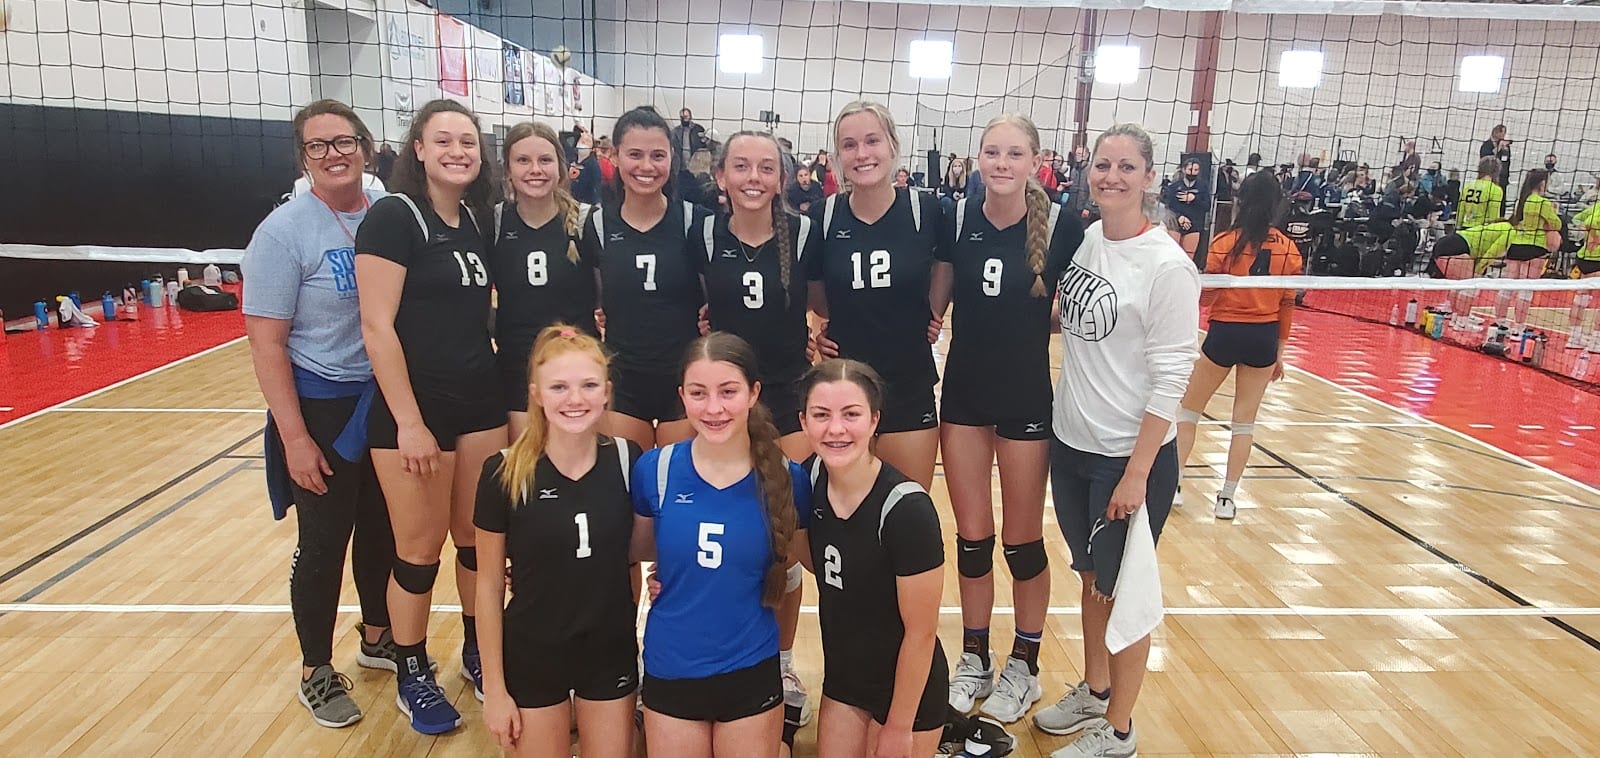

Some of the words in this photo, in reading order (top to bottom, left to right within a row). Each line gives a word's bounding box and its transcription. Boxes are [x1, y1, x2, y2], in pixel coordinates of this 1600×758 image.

[1465, 189, 1482, 204] 23
[453, 251, 488, 286] 13
[527, 251, 548, 286] 8
[635, 254, 657, 291] 7
[851, 250, 891, 290] 12
[982, 258, 1004, 297] 9
[742, 271, 764, 309] 3
[574, 512, 592, 559] 1
[697, 522, 725, 569] 5
[824, 544, 844, 590] 2
